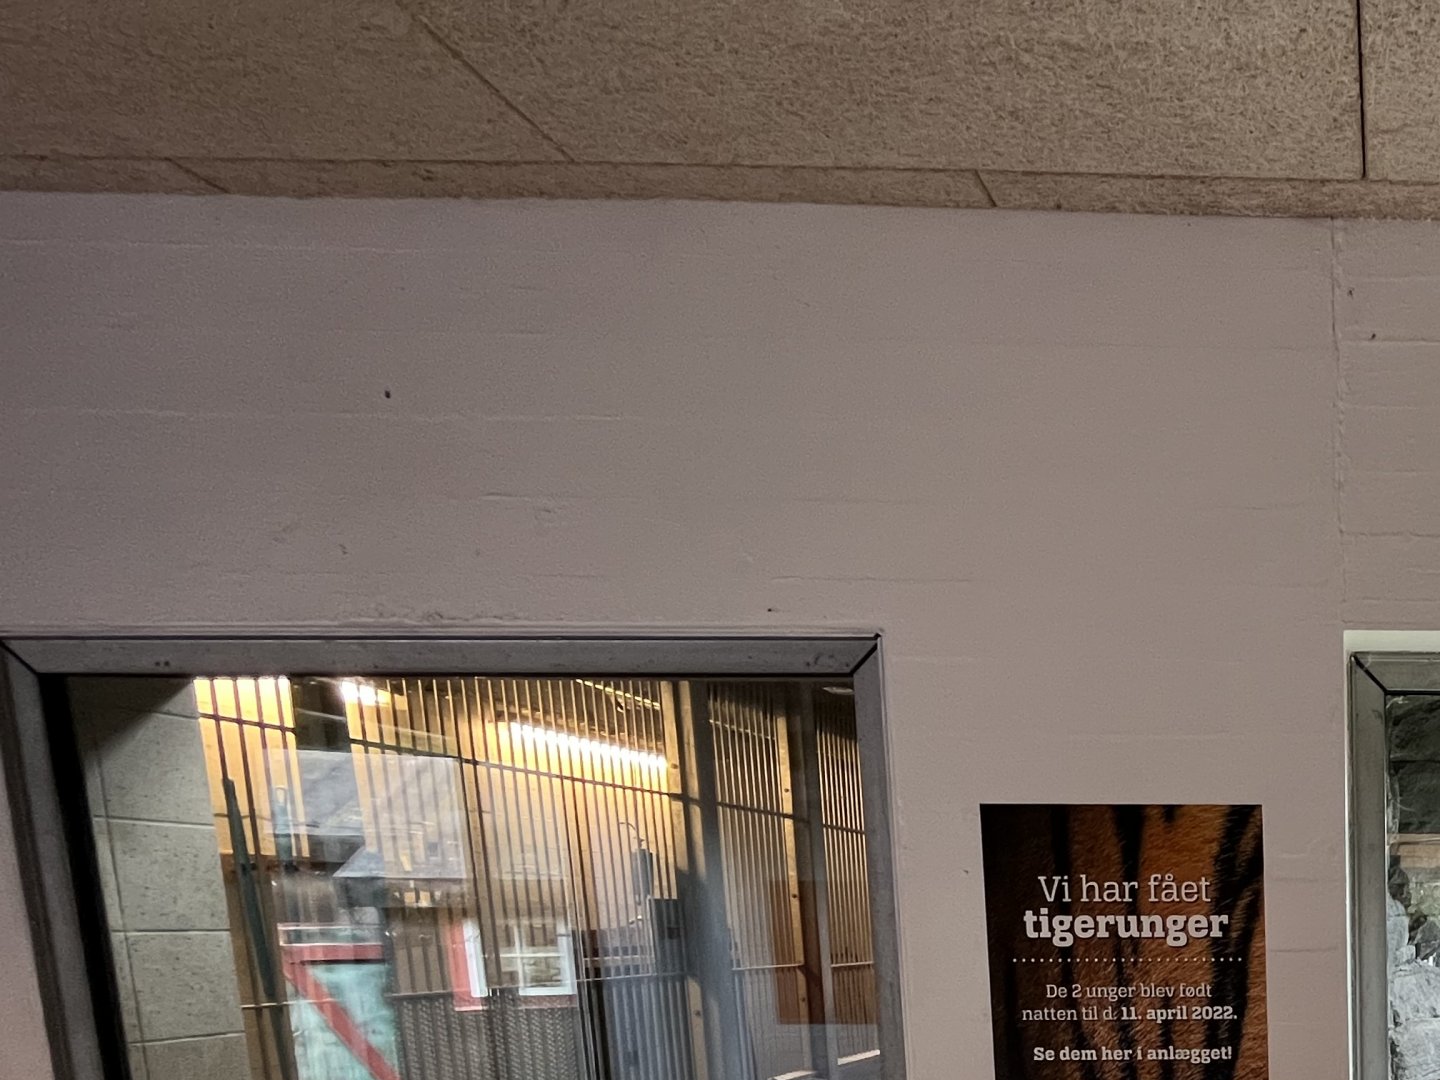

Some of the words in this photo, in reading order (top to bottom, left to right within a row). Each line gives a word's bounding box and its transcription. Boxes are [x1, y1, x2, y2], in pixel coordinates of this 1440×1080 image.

[1038, 875, 1071, 902] Vi
[1080, 874, 1138, 902] har
[1148, 873, 1211, 902] fået
[1023, 908, 1228, 947] tigerunger
[1046, 984, 1067, 998] De
[1072, 984, 1081, 998] 2
[1086, 986, 1136, 1001] unger
[1140, 983, 1174, 998] blev
[1179, 983, 1212, 998] født
[1022, 1007, 1077, 1021] natten
[1081, 1006, 1098, 1021] til
[1121, 1006, 1142, 1020] 11.
[1146, 1006, 1187, 1023] april
[1191, 1006, 1238, 1020] 2022.
[1033, 1047, 1055, 1061] Se
[1059, 1046, 1097, 1061] dem
[1101, 1046, 1132, 1061] her
[1136, 1046, 1143, 1060] i
[1147, 1046, 1232, 1063] anlægget!
